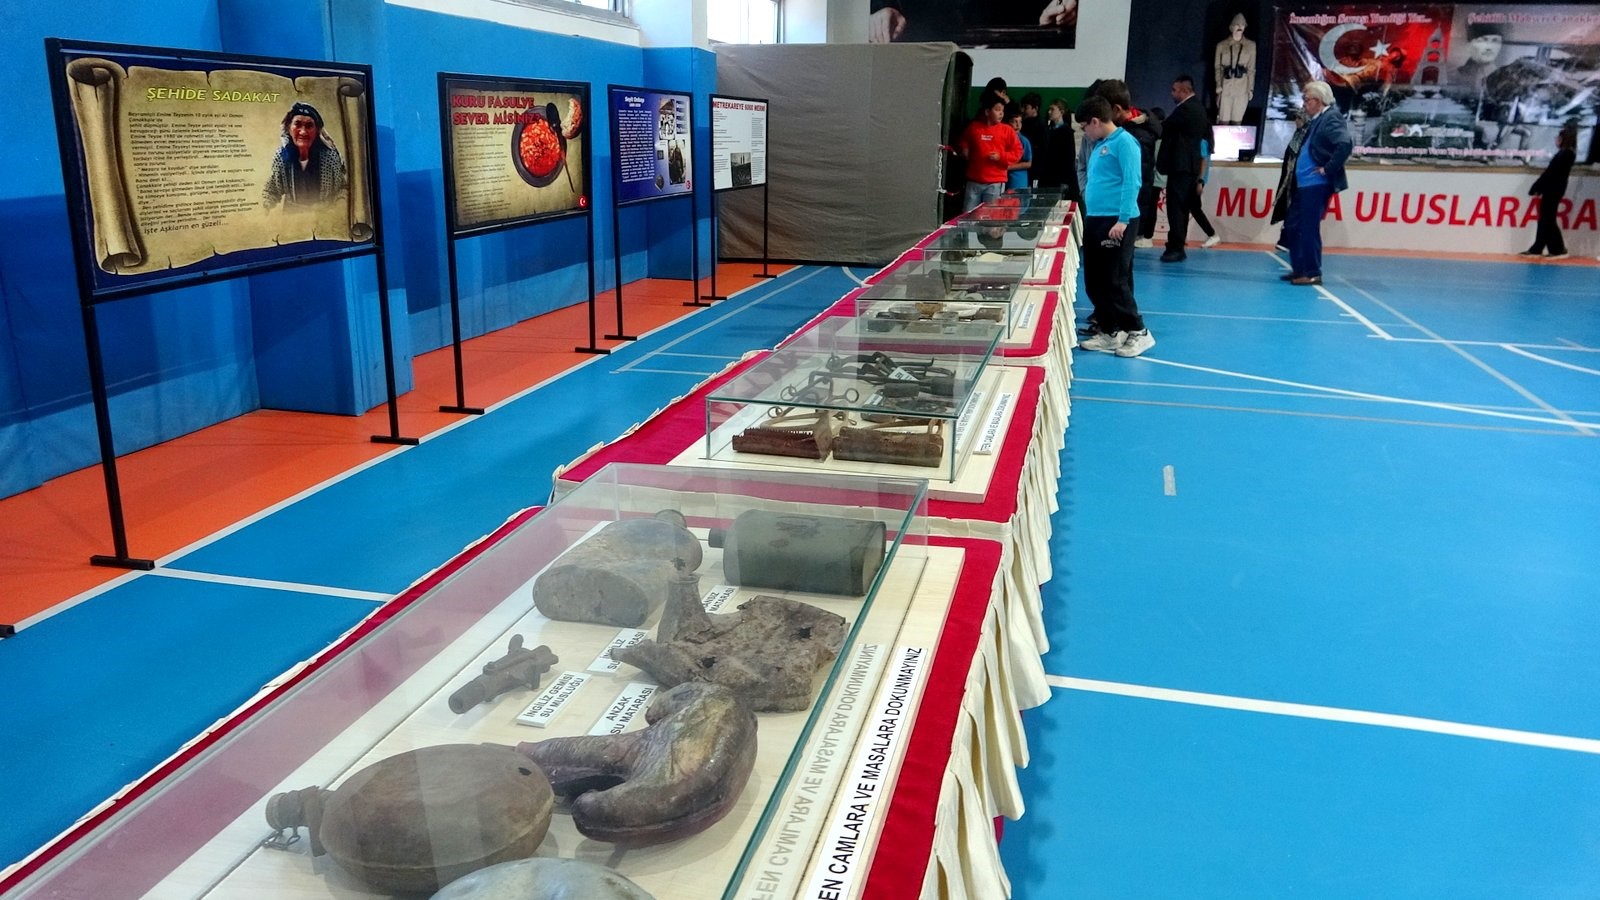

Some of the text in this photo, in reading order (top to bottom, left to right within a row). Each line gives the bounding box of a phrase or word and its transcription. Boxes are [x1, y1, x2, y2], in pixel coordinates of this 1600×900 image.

[147, 86, 280, 102] ŞEHİDE SADAKAT
[452, 94, 535, 109] KURU FASULYE
[452, 111, 489, 126] SEVER
[1216, 187, 1343, 221] MUA
[160, 224, 189, 233] Aşkların
[523, 673, 575, 717] İNGİLİZ GEMİSİ
[540, 677, 584, 718] SU MUSLUĞU
[885, 648, 922, 715] DOKUNMAYINIZ
[606, 696, 632, 721] ANZAK
[610, 687, 654, 734] SU MATARASI
[862, 718, 898, 780] MASALARA
[854, 783, 875, 800] VE
[828, 802, 870, 874] CAMLARA
